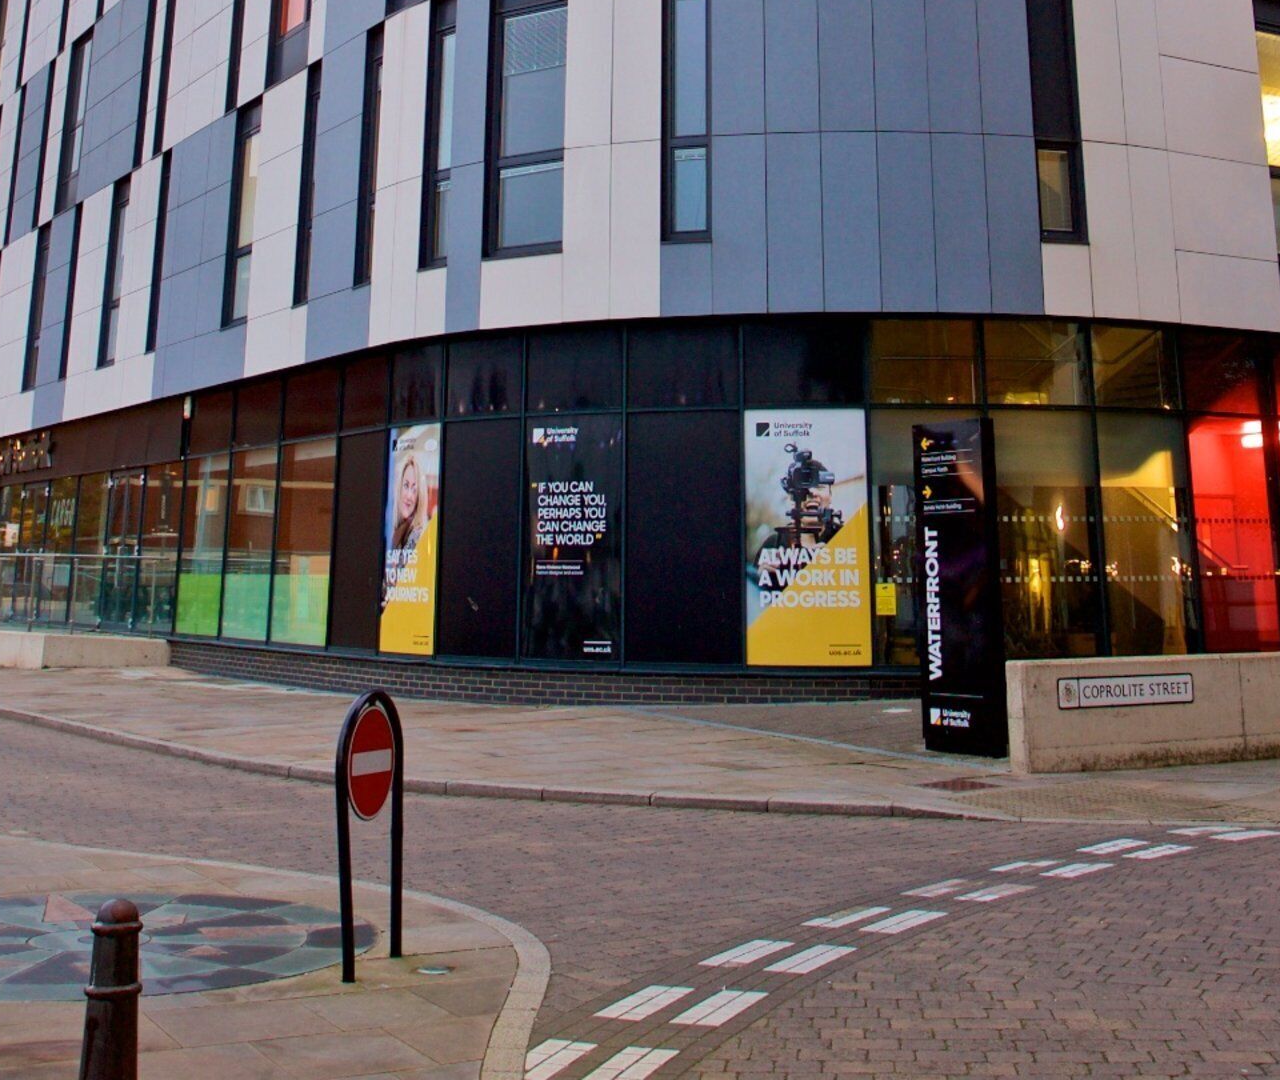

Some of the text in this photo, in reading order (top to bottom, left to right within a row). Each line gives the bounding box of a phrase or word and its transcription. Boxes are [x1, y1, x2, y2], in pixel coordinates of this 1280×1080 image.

[546, 427, 579, 435] University
[774, 422, 812, 430] University
[546, 434, 576, 442] of Suffolk
[783, 429, 810, 437] Suffolk
[548, 481, 568, 493] YOU
[570, 481, 594, 493] CAN
[538, 494, 607, 507] CHANGE YOU,
[538, 507, 606, 519] PERHAPS YOU
[536, 520, 606, 532] CAN CHANGE
[535, 533, 554, 545] THE
[386, 549, 418, 565] SAY YES
[758, 546, 857, 565] ALWAYS BE
[386, 568, 416, 583] TO NEW
[758, 569, 859, 586] A WORK IN
[386, 587, 429, 603] JOURNEYS
[759, 590, 861, 608] PROGRESS
[924, 526, 944, 681] WATERFRONT
[1082, 681, 1189, 700] COPROLITE STREET
